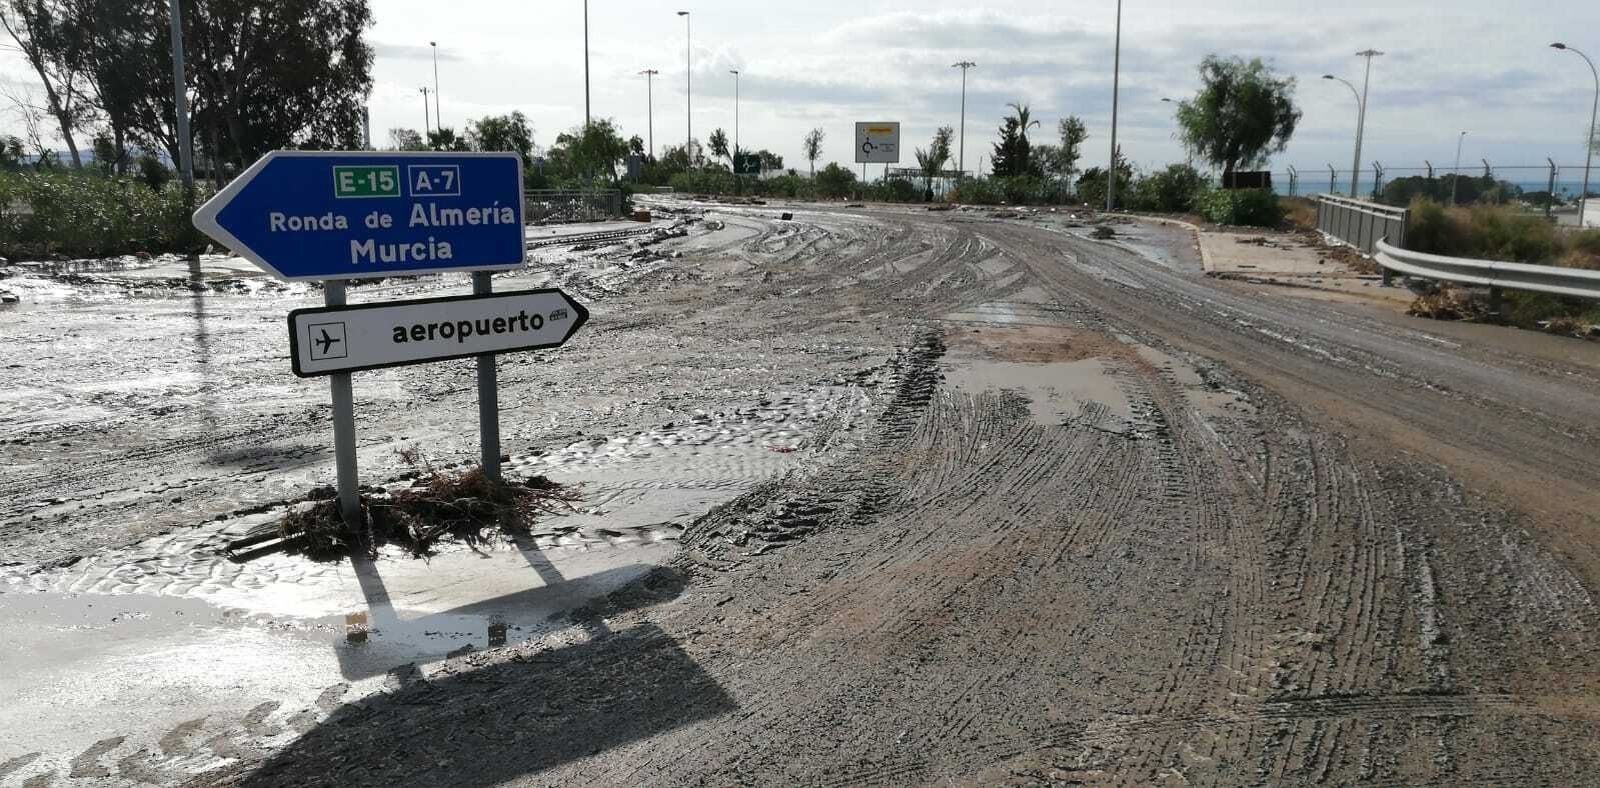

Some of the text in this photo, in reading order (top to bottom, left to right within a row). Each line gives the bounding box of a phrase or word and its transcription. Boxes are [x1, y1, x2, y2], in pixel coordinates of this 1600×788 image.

[339, 170, 394, 192] E-15
[415, 170, 454, 191] A-7
[269, 201, 515, 232] Ronda de Almería
[350, 236, 453, 264] Murcia
[392, 310, 544, 343] aeropuerto
